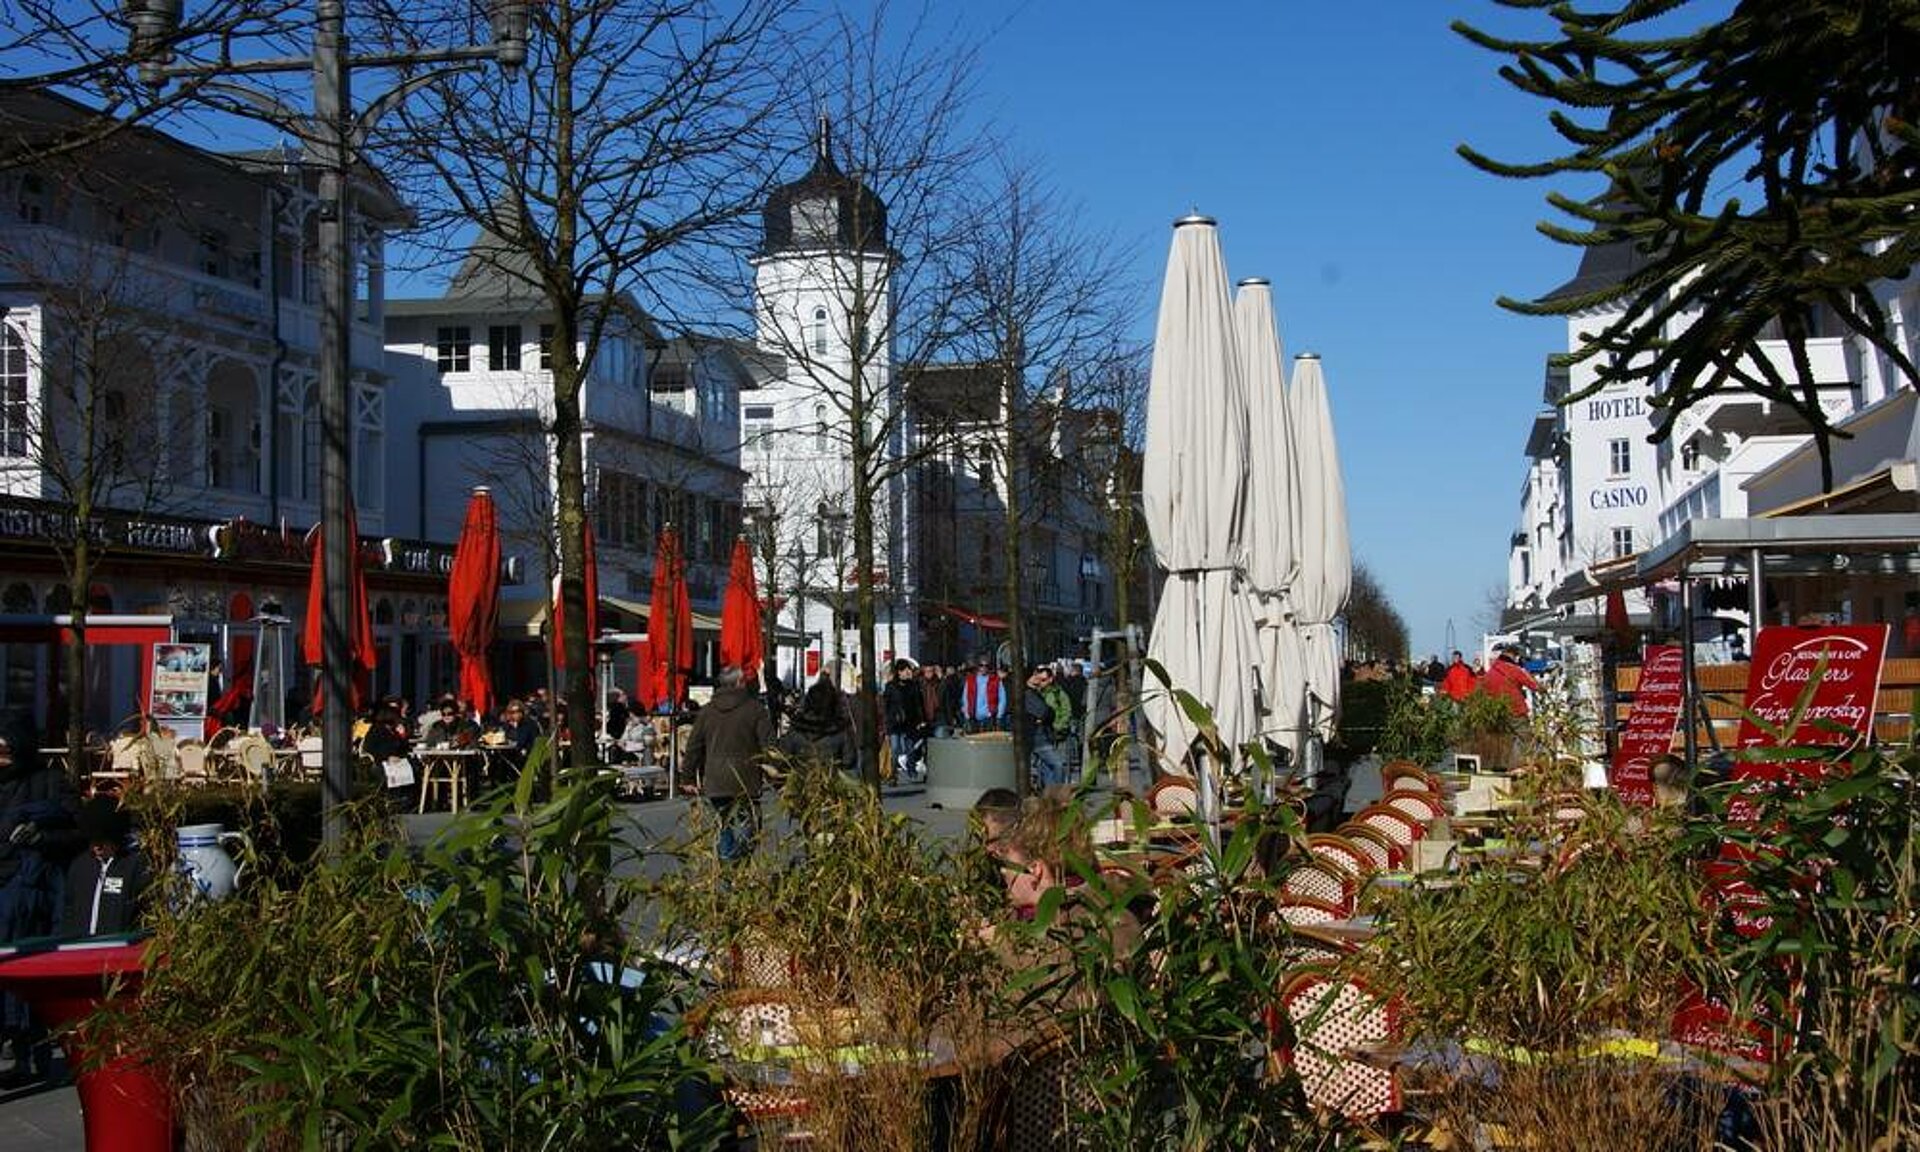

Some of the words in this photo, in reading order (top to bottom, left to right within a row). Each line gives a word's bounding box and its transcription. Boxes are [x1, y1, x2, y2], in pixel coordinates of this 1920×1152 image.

[1588, 396, 1646, 421] HOTEL
[1590, 485, 1648, 510] CASINO
[127, 521, 196, 550] PIZZERIA
[1762, 652, 1854, 690] Glasers
